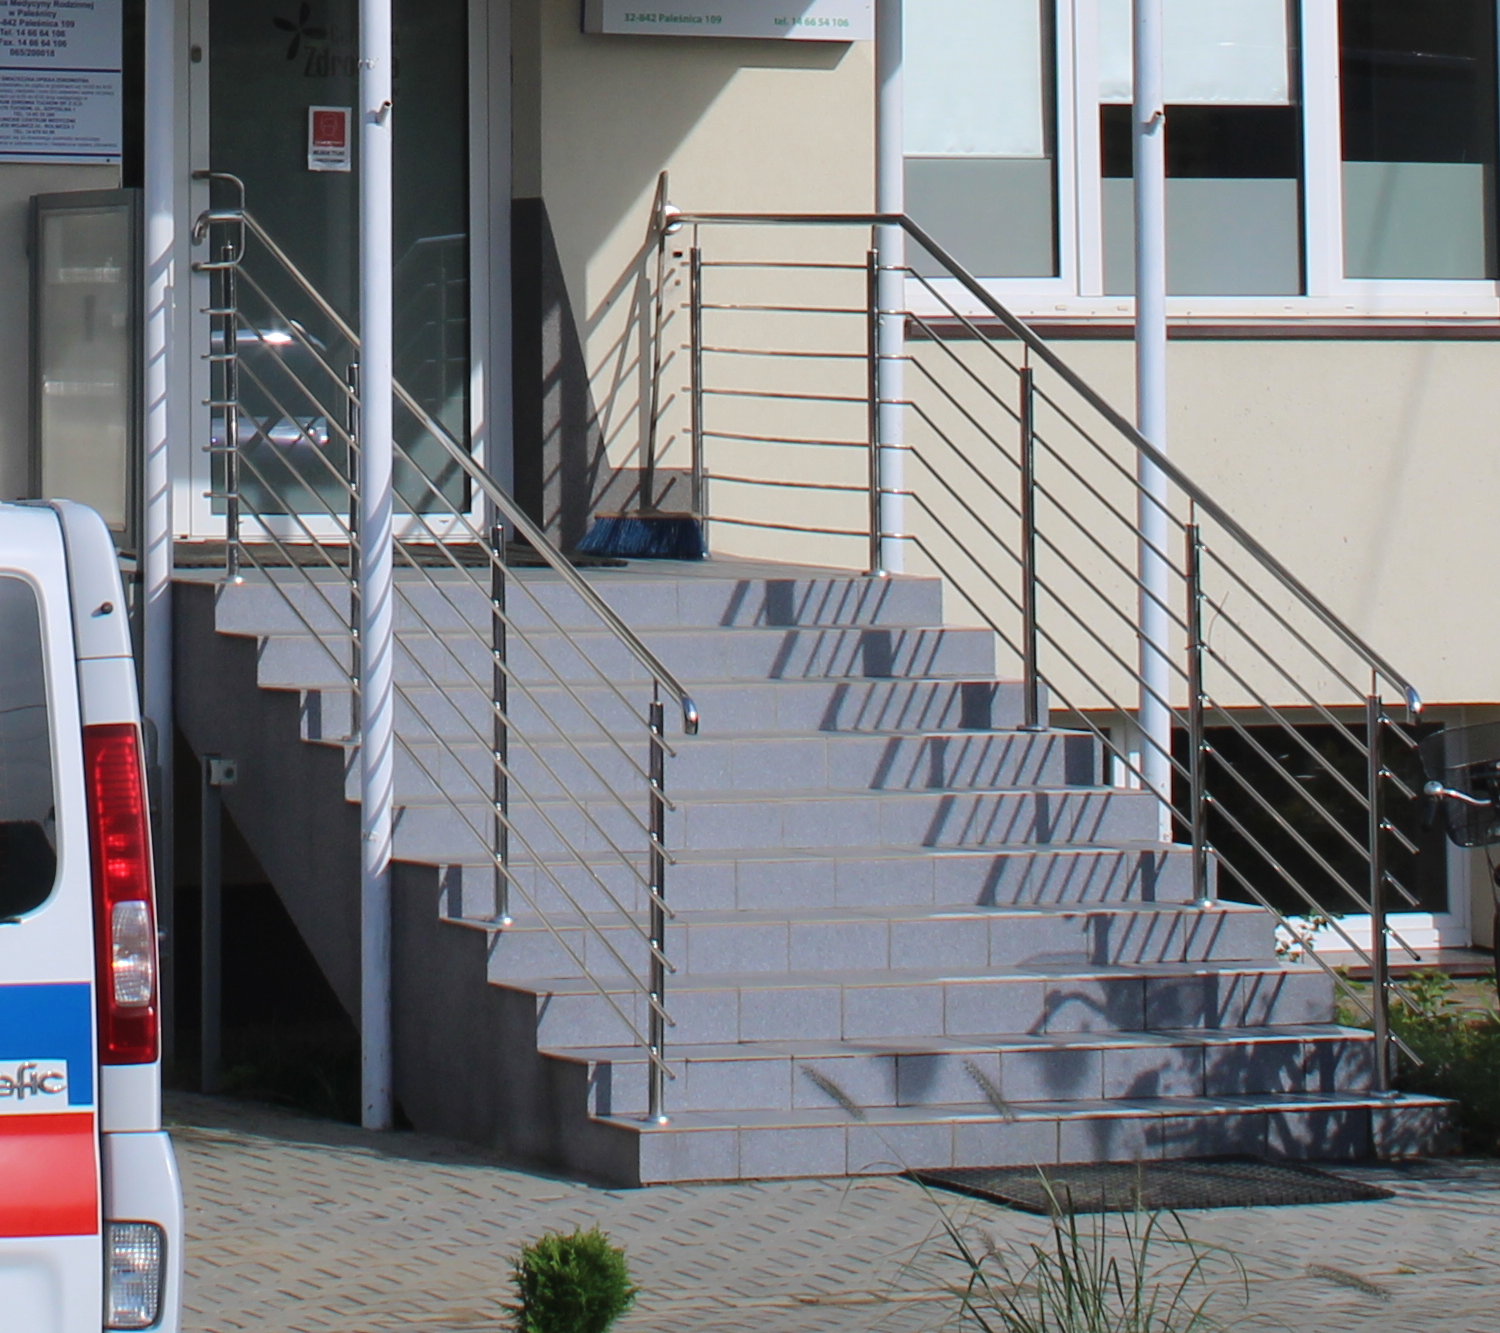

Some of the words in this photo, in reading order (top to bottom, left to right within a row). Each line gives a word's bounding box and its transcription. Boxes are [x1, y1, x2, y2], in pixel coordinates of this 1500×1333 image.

[9, 0, 51, 9] Medycyny
[624, 12, 657, 24] 32-842
[658, 13, 703, 25] Paleśnica
[774, 16, 789, 27] tel.
[804, 17, 816, 27] 66
